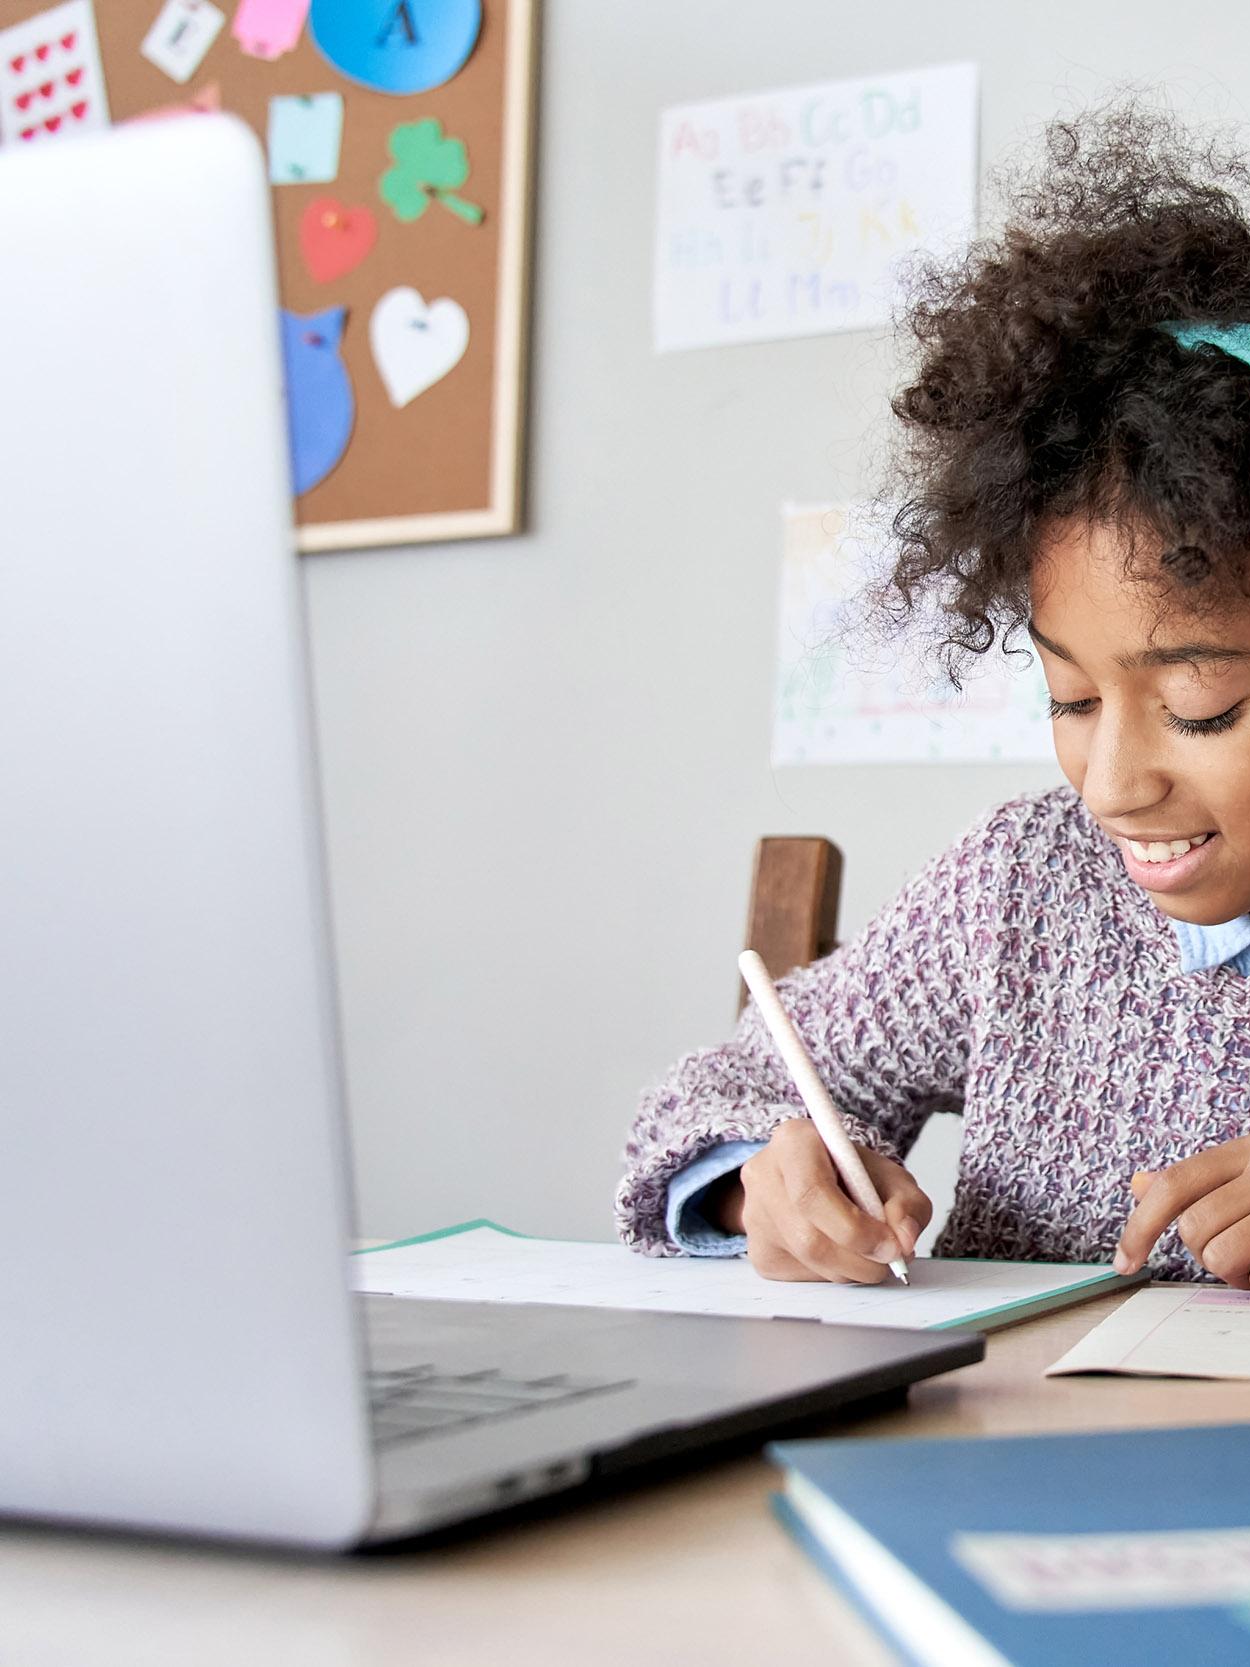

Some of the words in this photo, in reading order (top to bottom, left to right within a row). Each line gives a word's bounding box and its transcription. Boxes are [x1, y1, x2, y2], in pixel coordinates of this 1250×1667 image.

[801, 96, 850, 148] Cc
[861, 84, 922, 139] Dd
[712, 169, 765, 209] Ee
